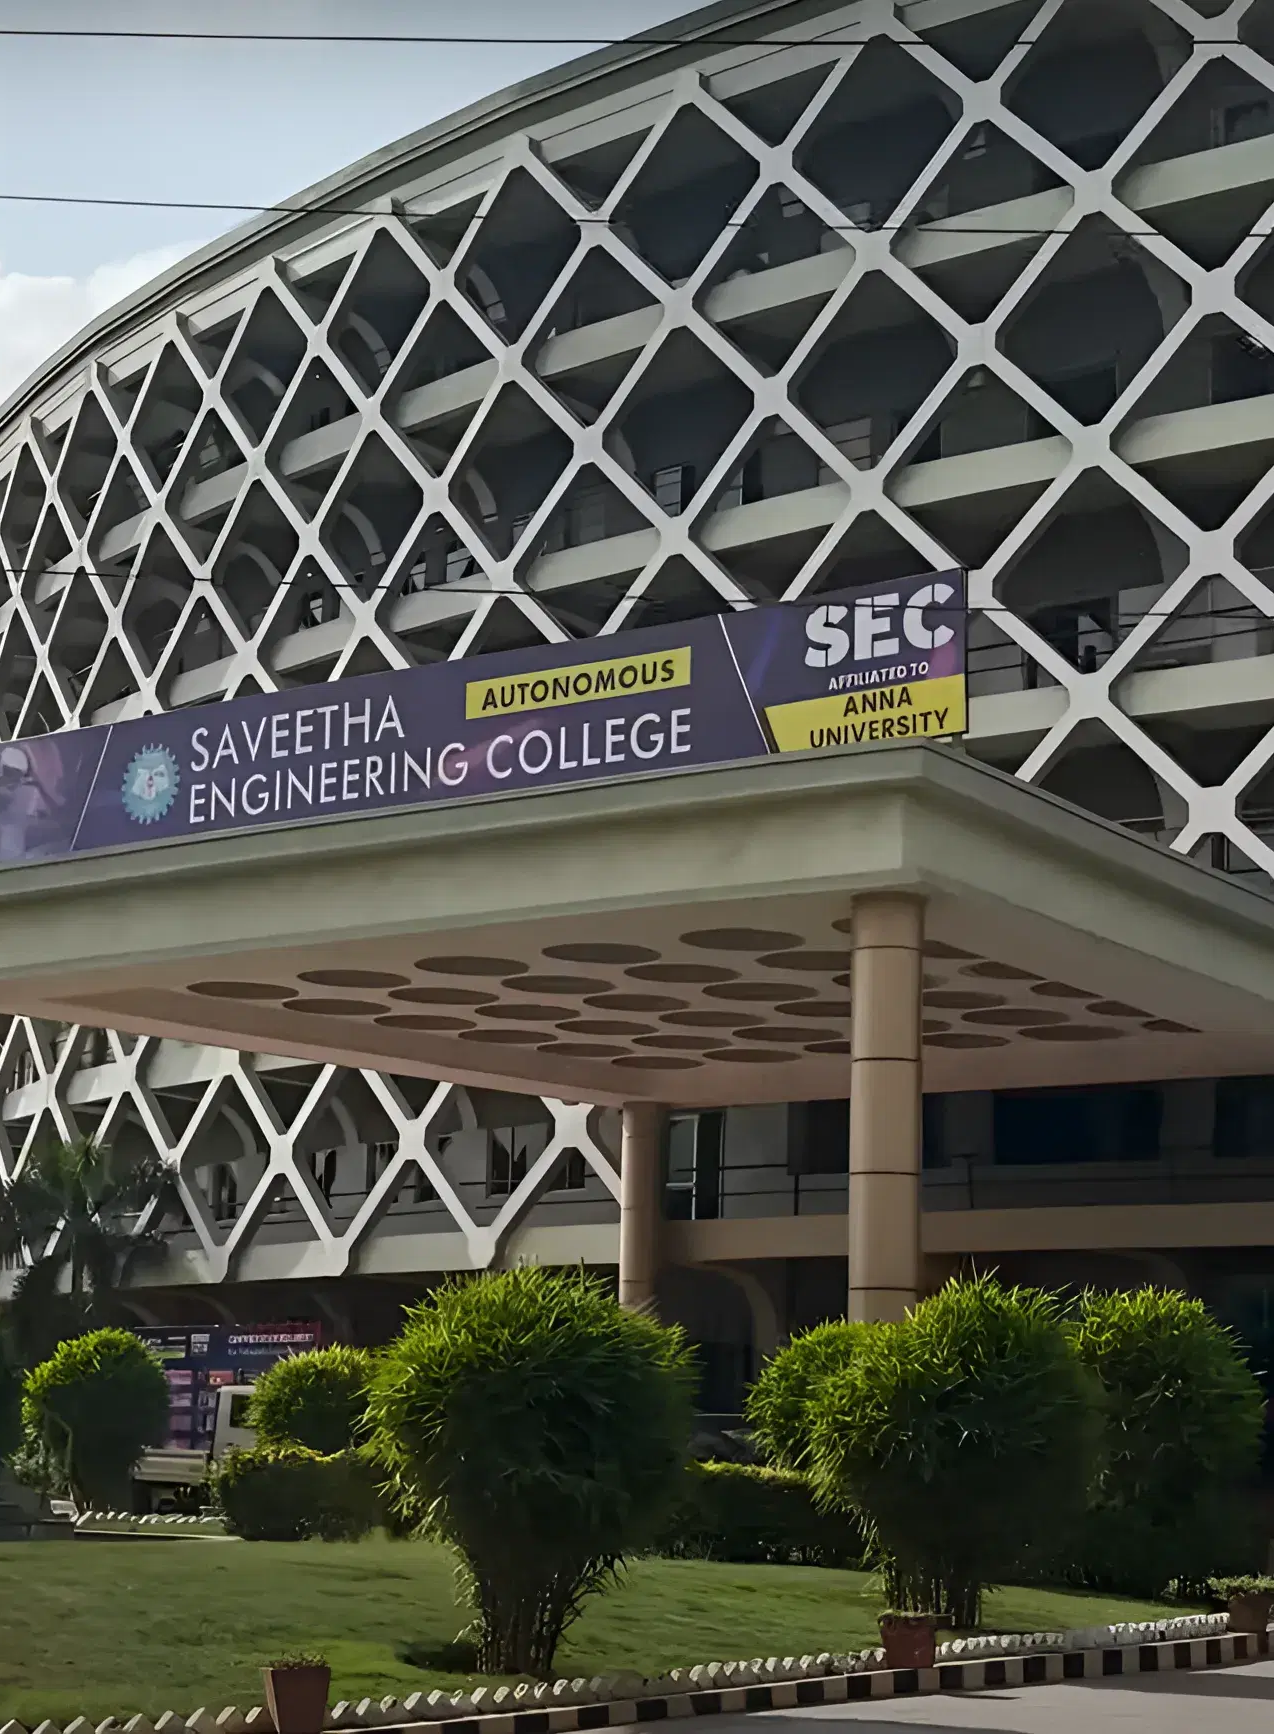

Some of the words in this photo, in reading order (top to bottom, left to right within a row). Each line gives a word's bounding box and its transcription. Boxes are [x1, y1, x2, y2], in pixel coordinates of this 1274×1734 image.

[804, 583, 955, 668] SEC
[481, 659, 675, 711] AUTONOMOUS
[910, 661, 929, 676] TO
[809, 707, 949, 748] UNIVERSITY
[843, 686, 913, 717] ANNA
[190, 694, 405, 773] SAVEETHA
[189, 742, 469, 824] ENGINEERING
[486, 707, 692, 779] COLLEGE
